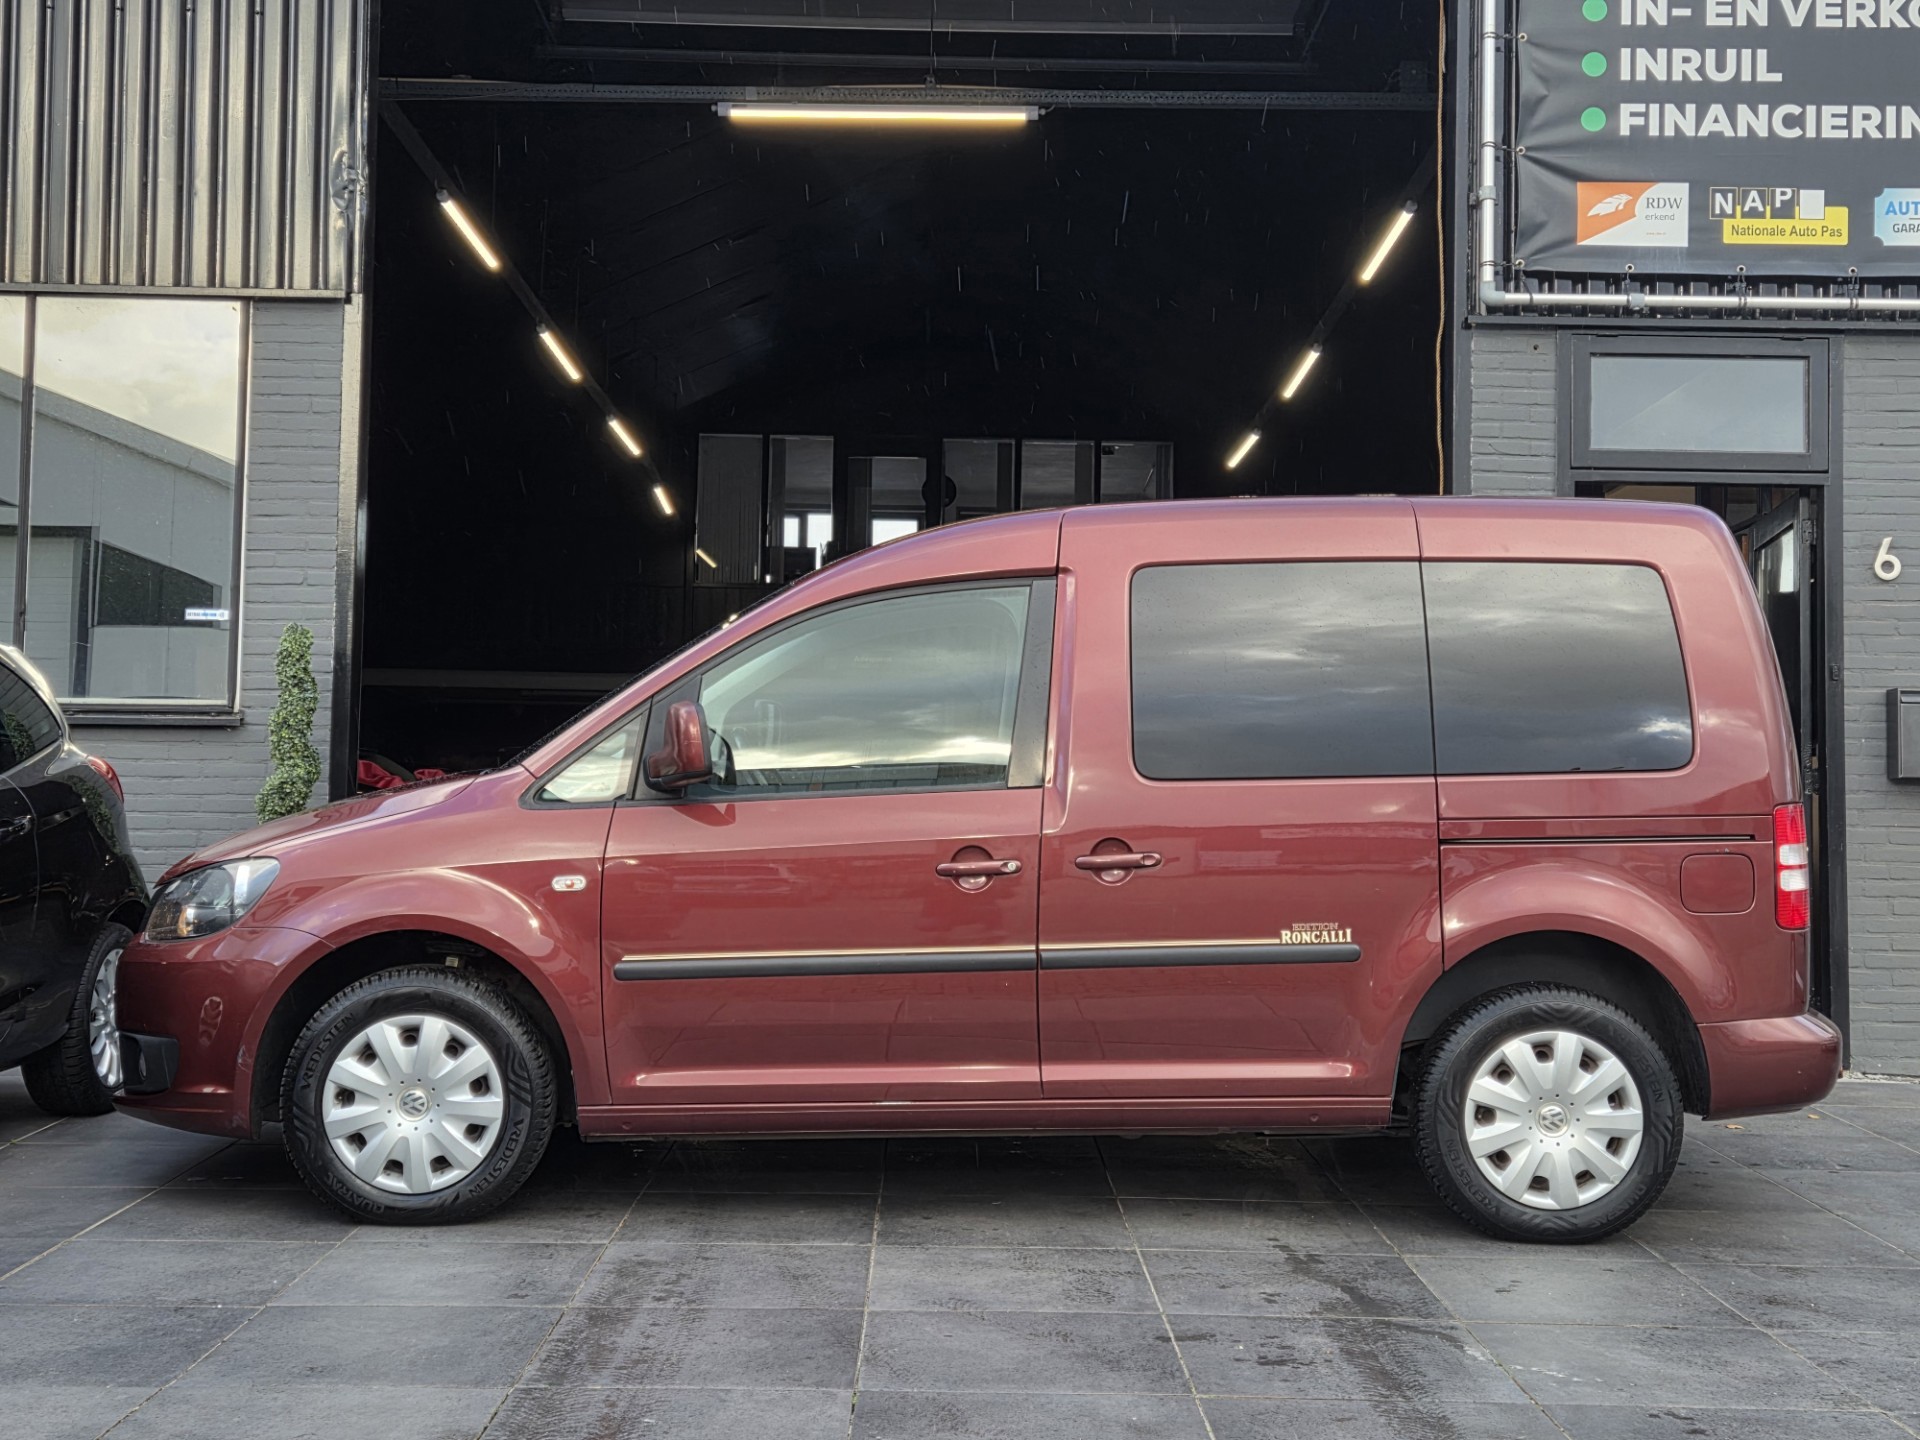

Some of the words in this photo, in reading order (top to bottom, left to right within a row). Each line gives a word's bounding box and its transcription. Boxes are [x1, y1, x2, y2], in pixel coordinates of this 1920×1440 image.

[1620, 0, 1692, 26] IN-
[1706, 0, 1768, 26] EN
[1620, 48, 1783, 82] INRUIL
[1619, 103, 1920, 139] FINANCIERIN
[1646, 197, 1682, 209] RDW
[1714, 187, 1793, 215] NAP
[1645, 213, 1675, 221] erkend
[1731, 224, 1787, 237] Nationale
[1789, 225, 1818, 237] Auto
[1821, 225, 1843, 237] Pas
[1874, 536, 1902, 581] 6
[1280, 928, 1352, 944] RONCALLI
[1292, 922, 1339, 931] EDITION
[300, 1012, 355, 1090] VREDESTEIN
[468, 1118, 525, 1198] VREDESTEIN
